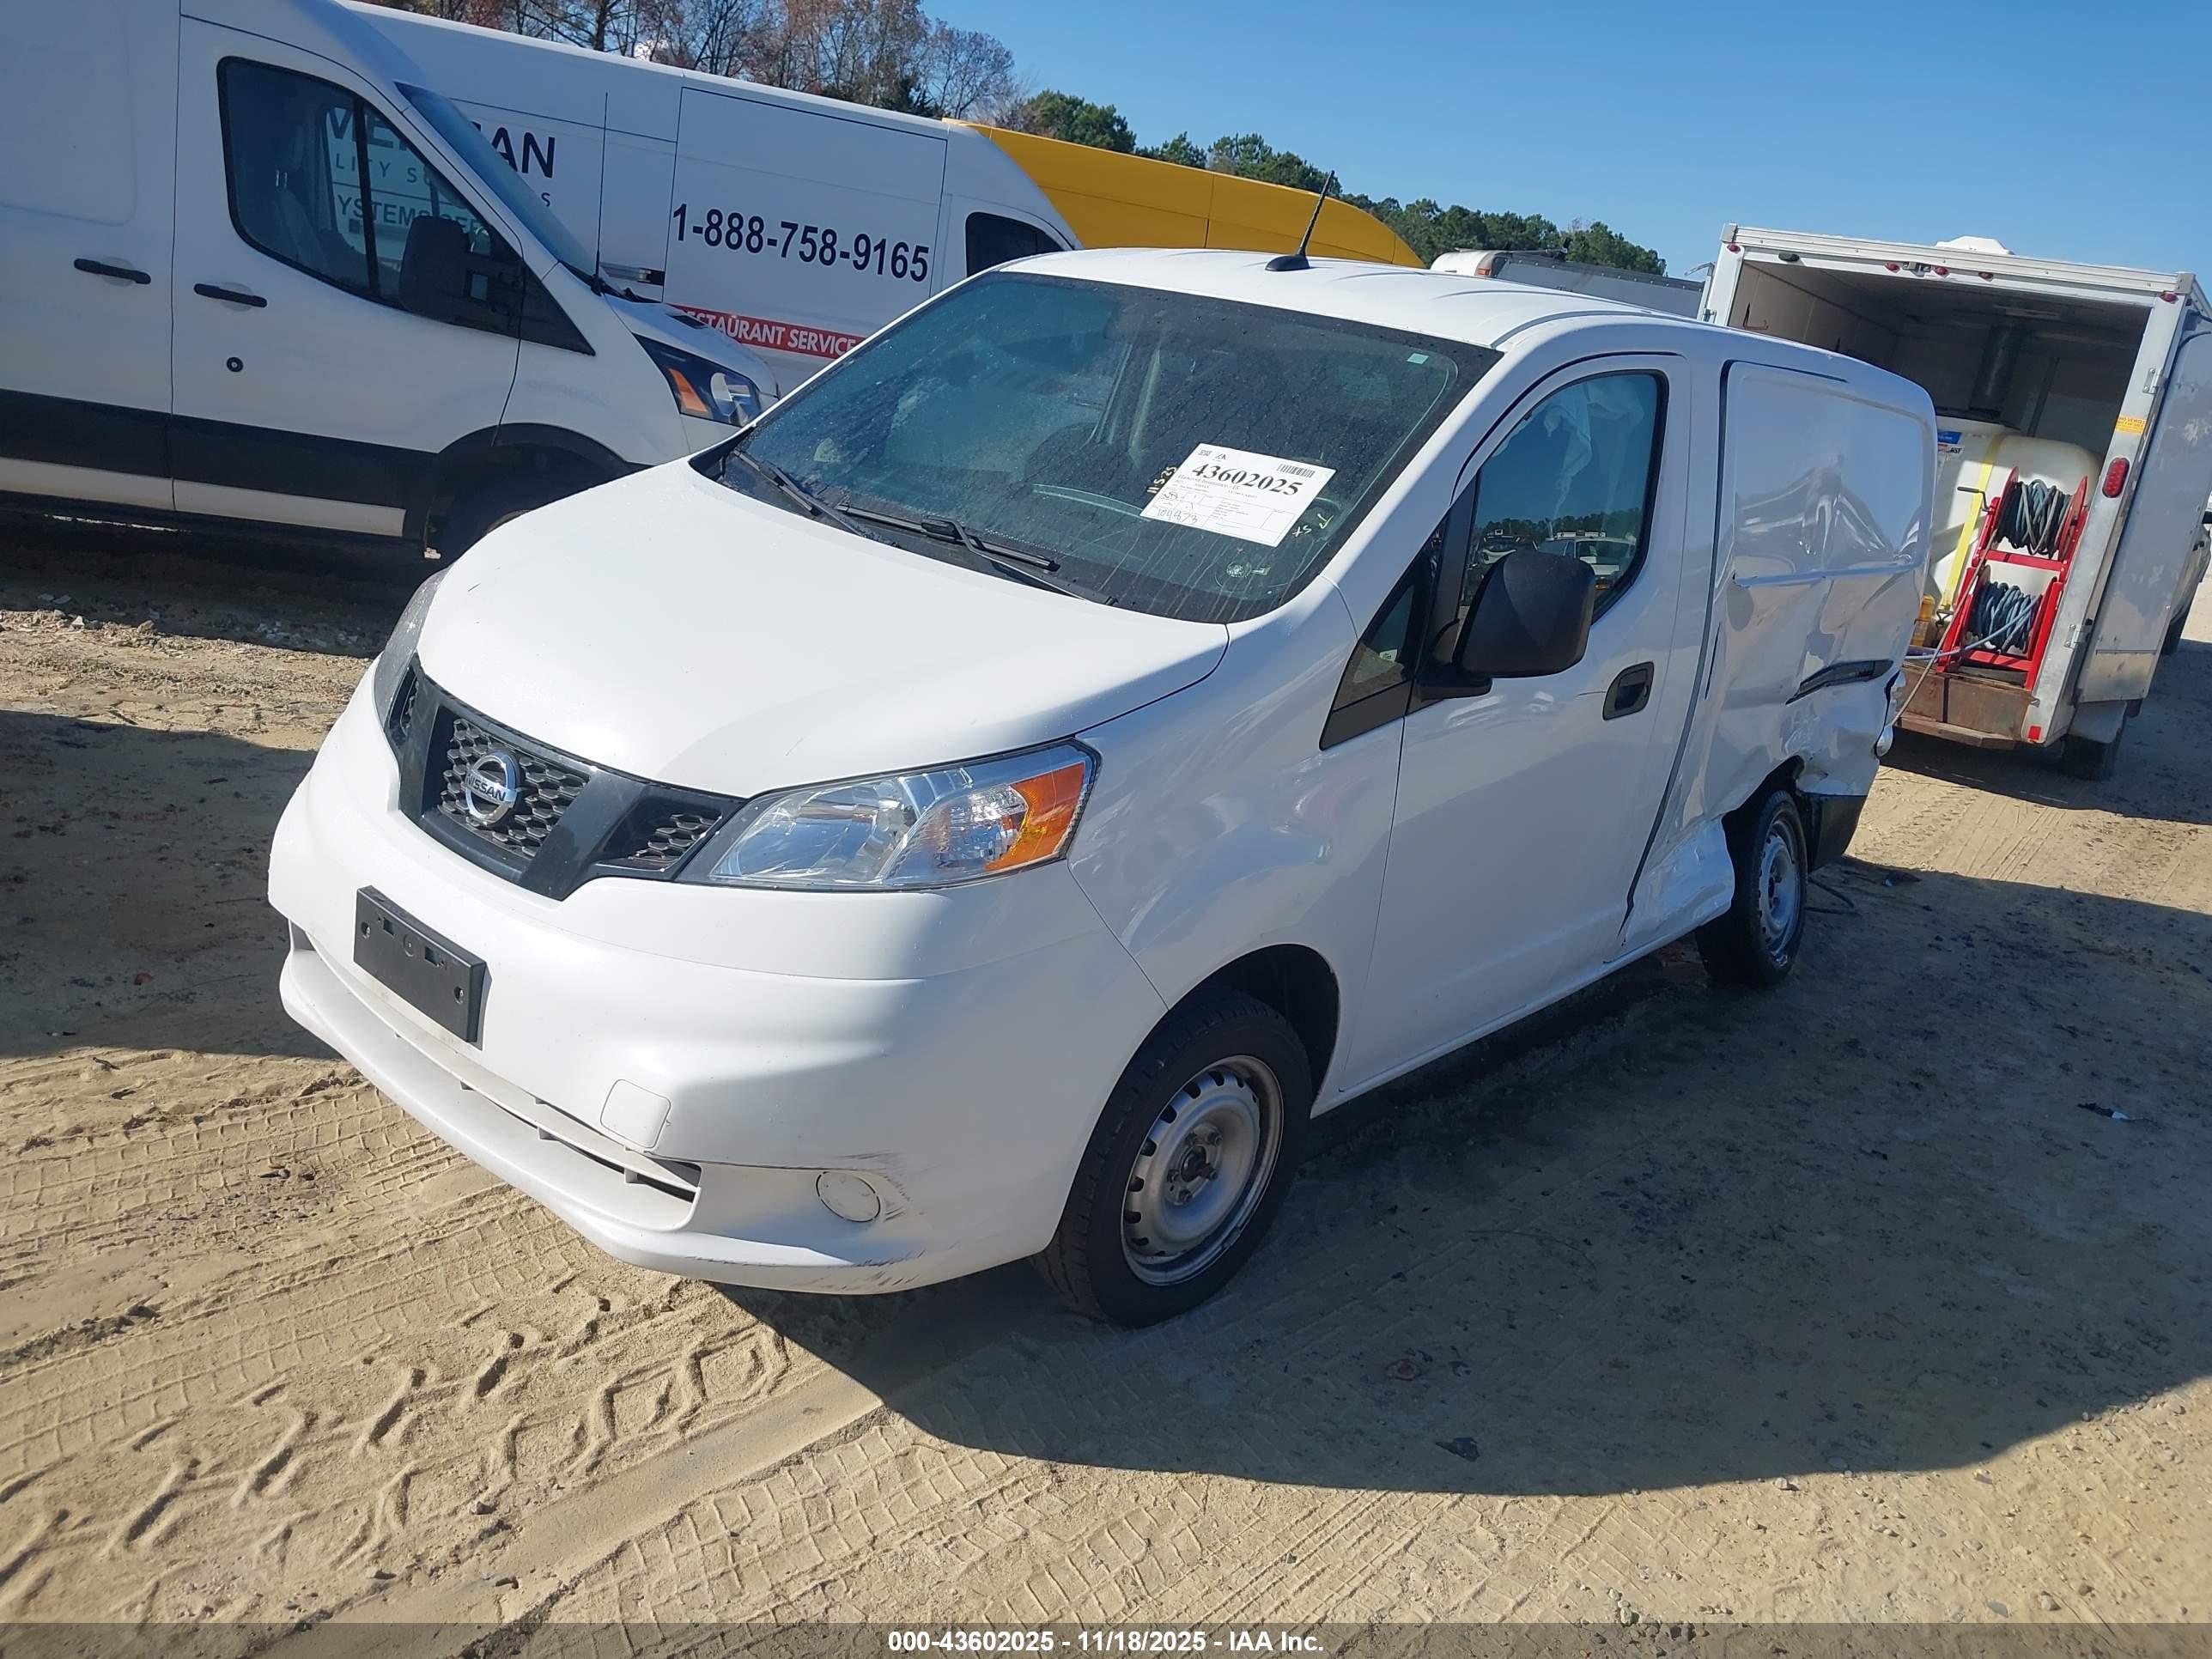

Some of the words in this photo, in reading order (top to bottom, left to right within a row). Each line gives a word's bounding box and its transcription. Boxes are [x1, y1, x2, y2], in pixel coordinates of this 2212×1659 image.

[672, 203, 929, 282] 1-888-758-9165
[1192, 463, 1304, 495] 43602025
[467, 773, 507, 802] NISSAN
